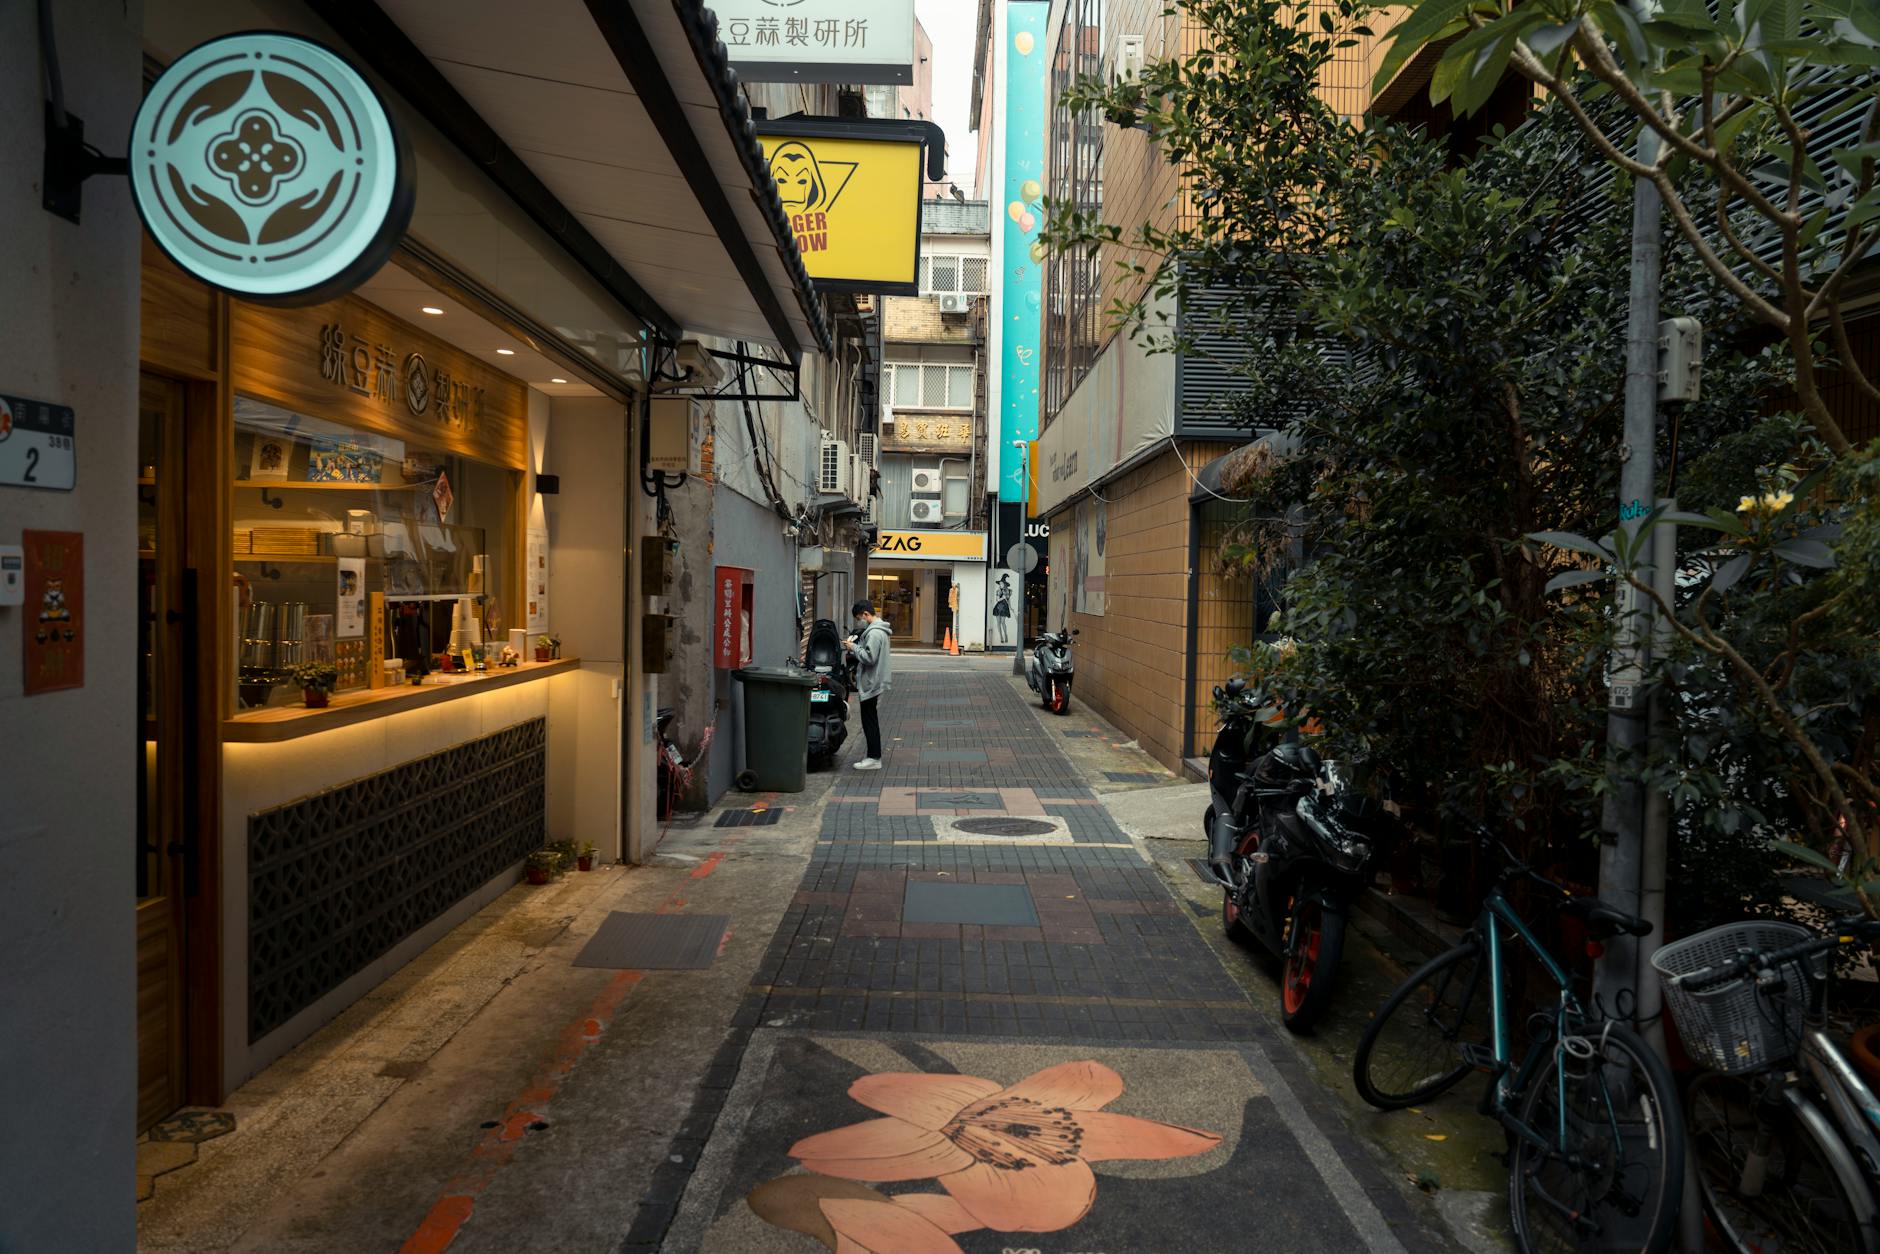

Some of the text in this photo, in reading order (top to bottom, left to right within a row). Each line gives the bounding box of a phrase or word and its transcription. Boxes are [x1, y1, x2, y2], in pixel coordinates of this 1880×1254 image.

[716, 17, 868, 48] 豆蒜製研所
[787, 212, 827, 233] GER
[23, 447, 39, 482] 2
